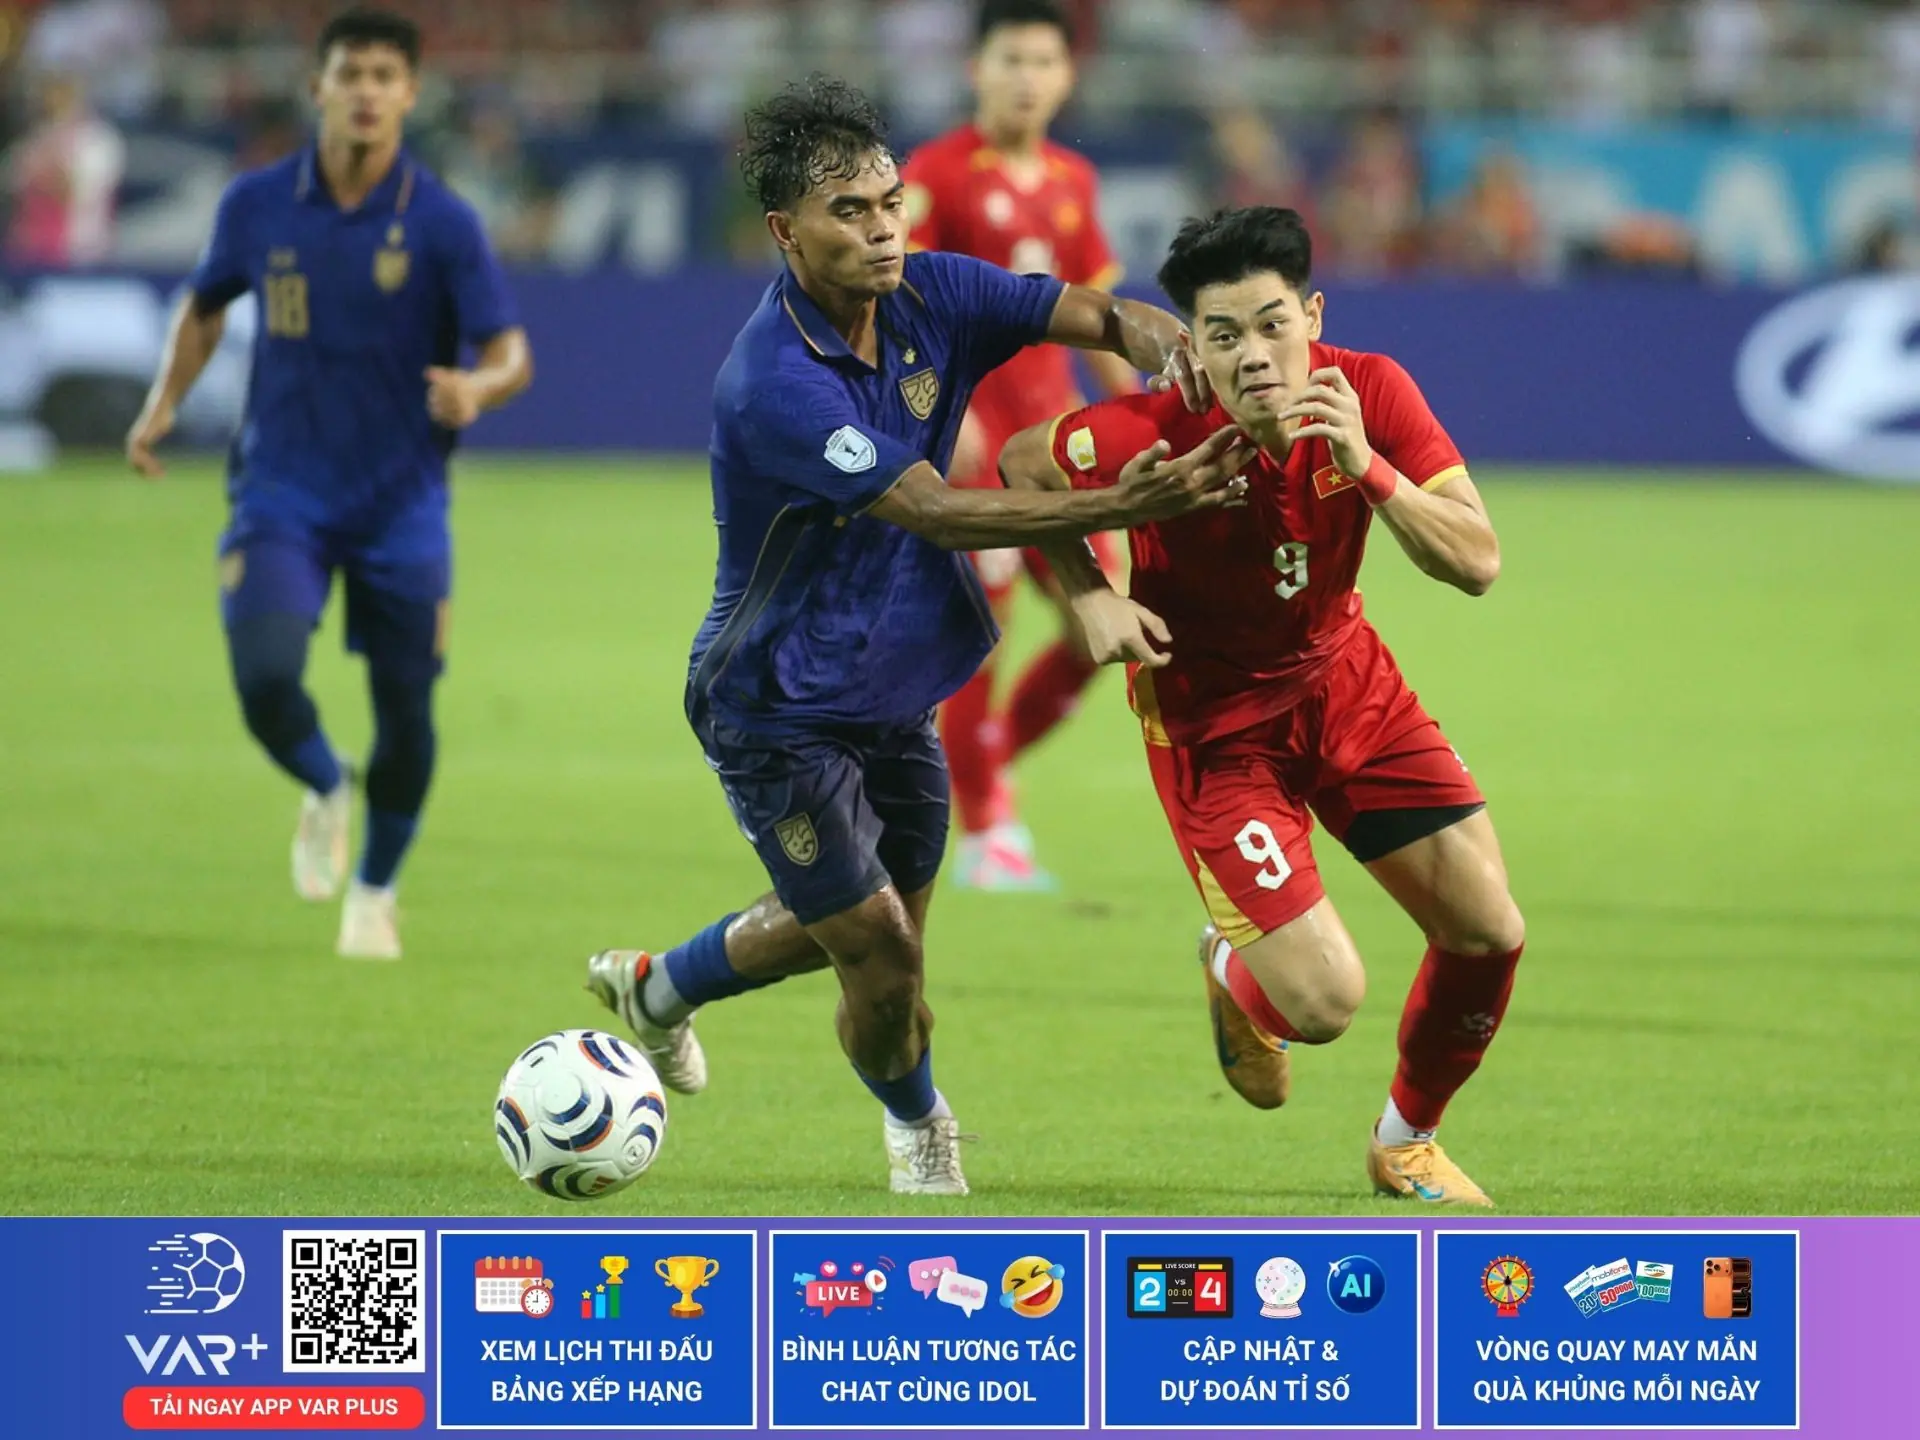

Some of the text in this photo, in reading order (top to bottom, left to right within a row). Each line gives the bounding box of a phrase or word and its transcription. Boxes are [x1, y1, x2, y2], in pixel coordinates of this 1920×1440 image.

[264, 274, 308, 337] 18
[1274, 542, 1308, 599] 9
[1234, 819, 1293, 890] 9
